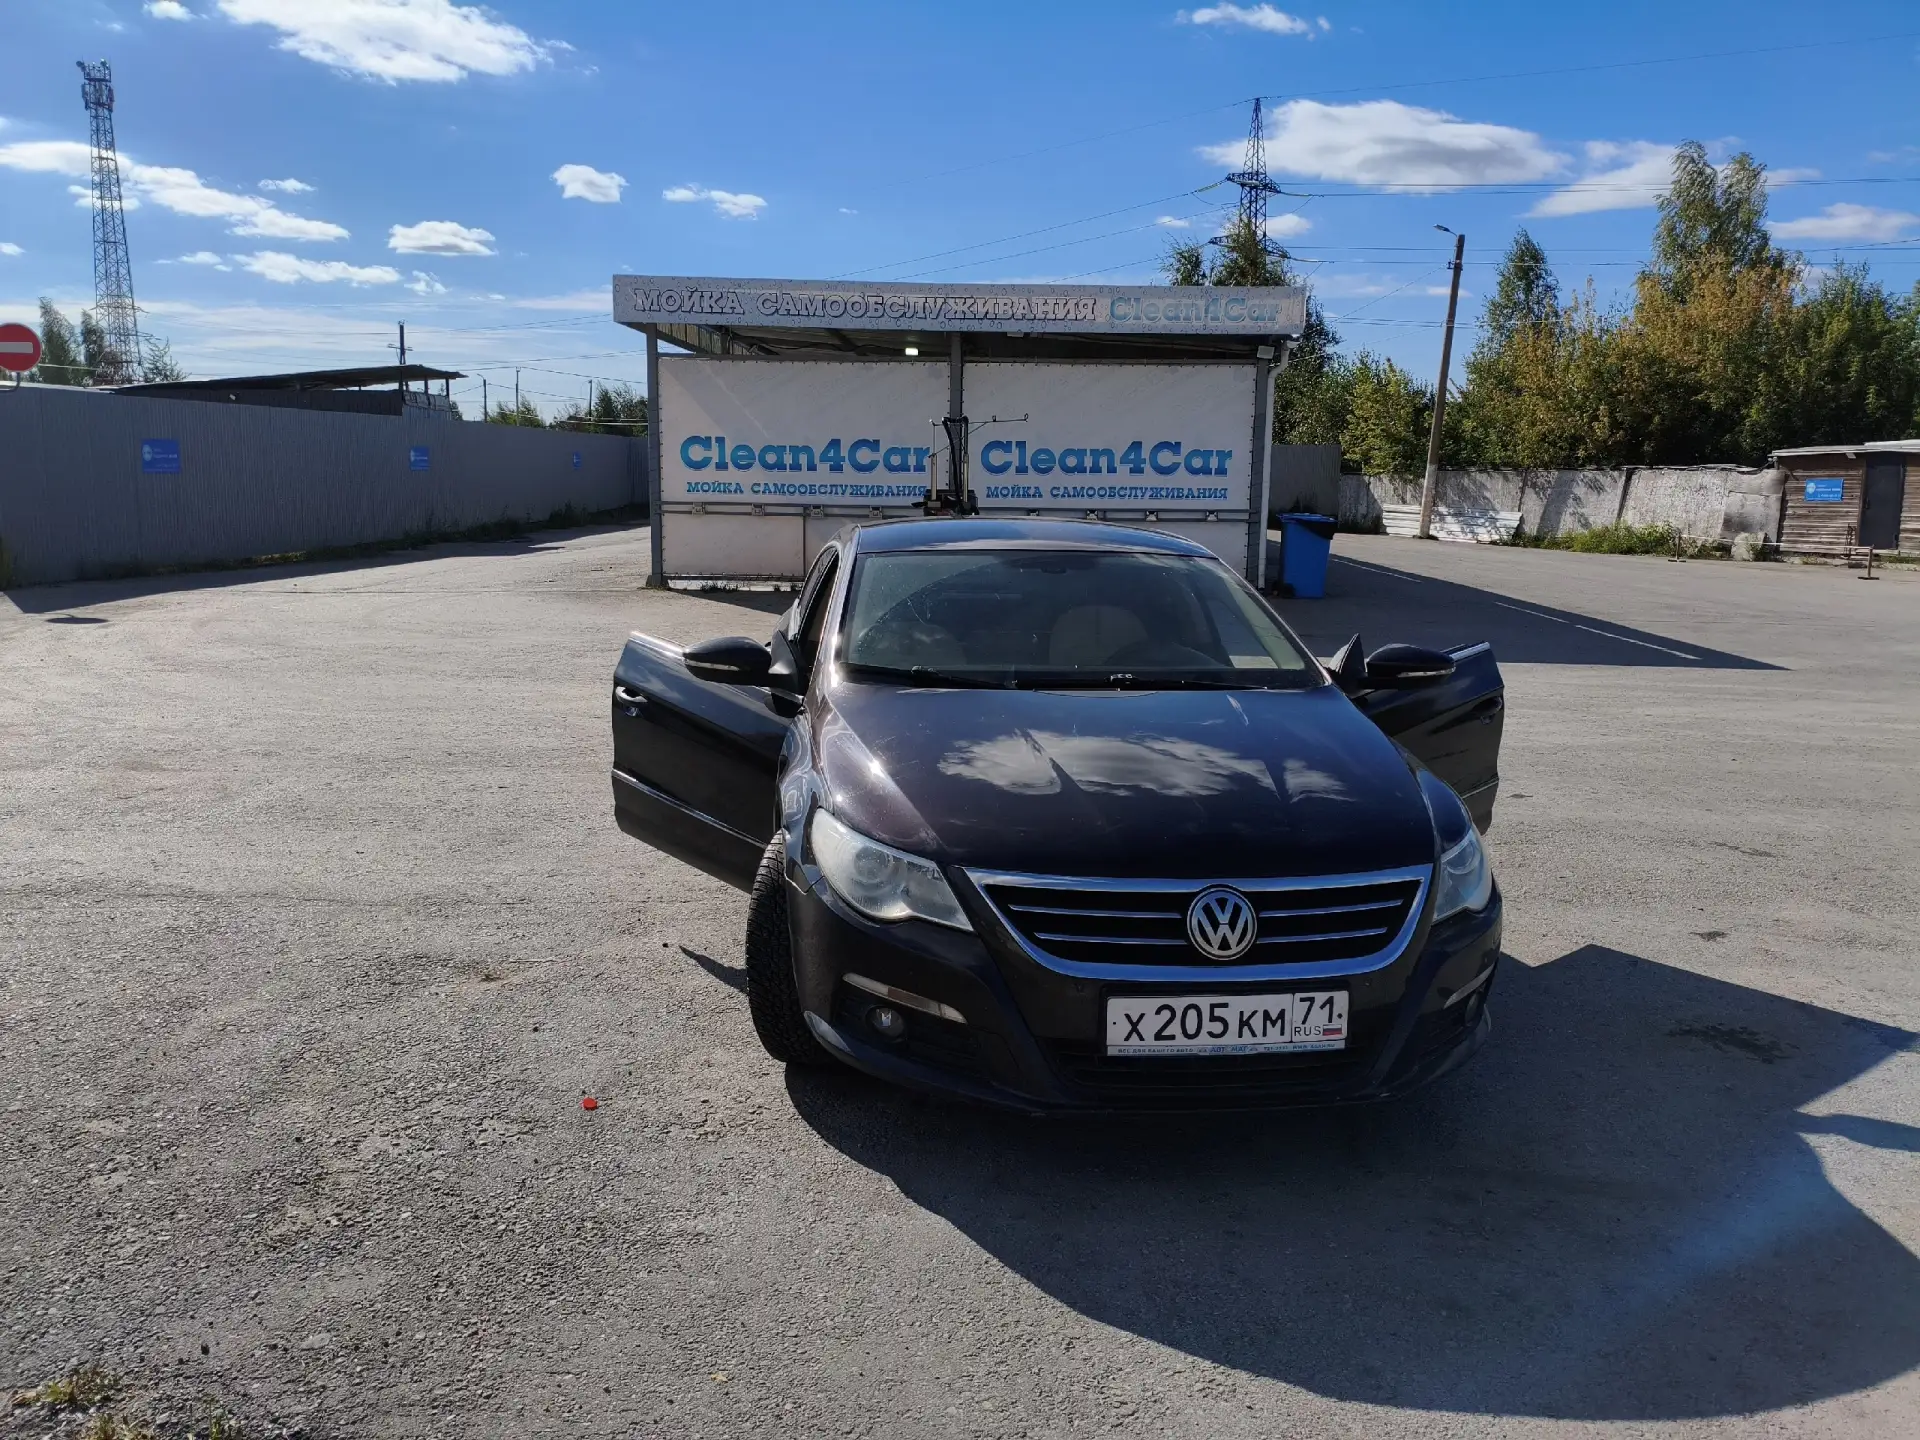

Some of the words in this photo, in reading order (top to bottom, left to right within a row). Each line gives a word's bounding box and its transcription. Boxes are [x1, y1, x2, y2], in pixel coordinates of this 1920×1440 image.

[633, 286, 746, 315] МОЙКА
[756, 292, 1097, 321] САМООБСЛУЖИВАНИЯ
[1109, 296, 1280, 324] Clean4Car
[679, 435, 932, 474] Clean4Car
[980, 440, 1233, 477] Clean4Car
[686, 480, 744, 494] МОЙКА
[750, 482, 927, 497] САМООБСЛУЖИВАНИЯ
[986, 484, 1044, 499] МОЙКА
[1050, 486, 1229, 500] САМООБСЛУЖИВАНИЯ
[1299, 995, 1336, 1025] 71
[1294, 1025, 1322, 1037] RUS
